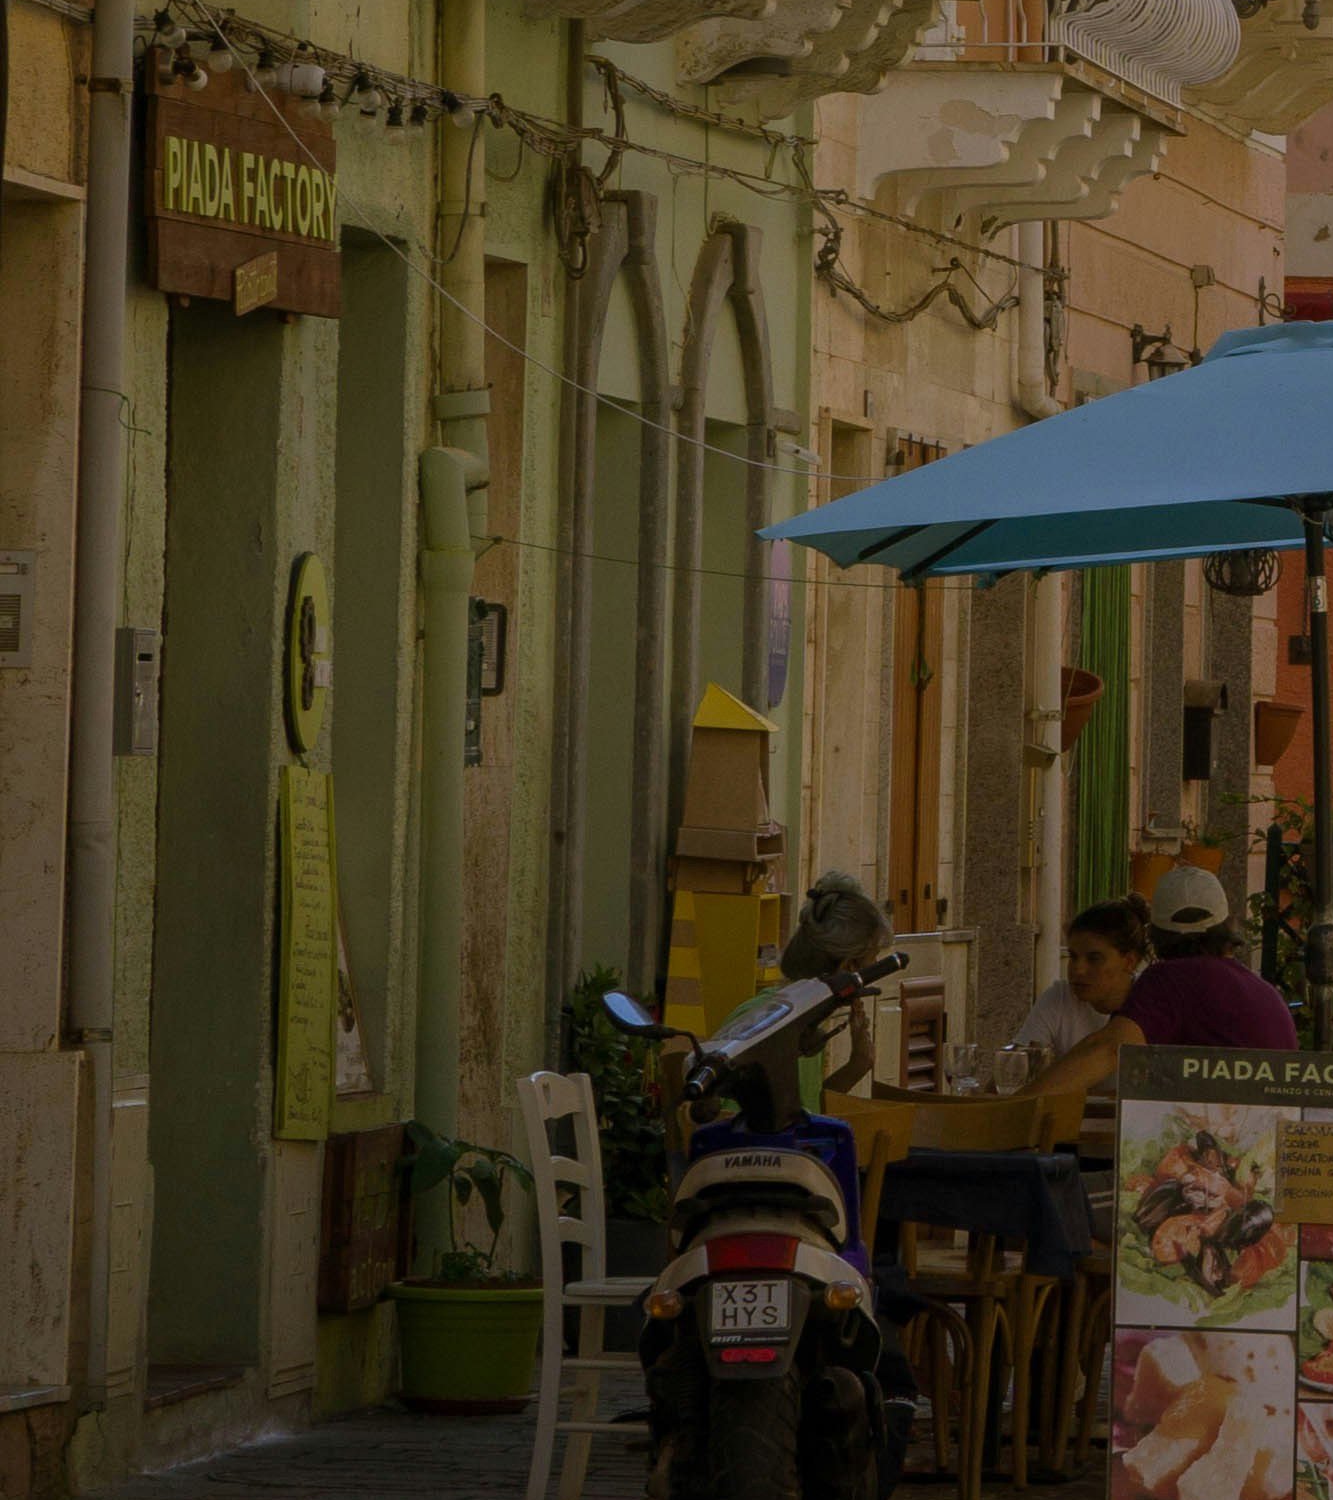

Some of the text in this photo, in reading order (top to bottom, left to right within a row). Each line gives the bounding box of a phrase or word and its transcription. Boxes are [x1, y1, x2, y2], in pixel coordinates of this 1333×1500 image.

[164, 135, 338, 242] PIADA FACTORY
[1182, 1056, 1276, 1083] PIADA
[1263, 1085, 1303, 1096] PRANZO
[1304, 1088, 1311, 1096] E
[723, 1155, 783, 1169] YAMAHA
[1280, 1165, 1321, 1178] PIADINA
[721, 1283, 778, 1305] X3T
[721, 1305, 778, 1327] HYS
